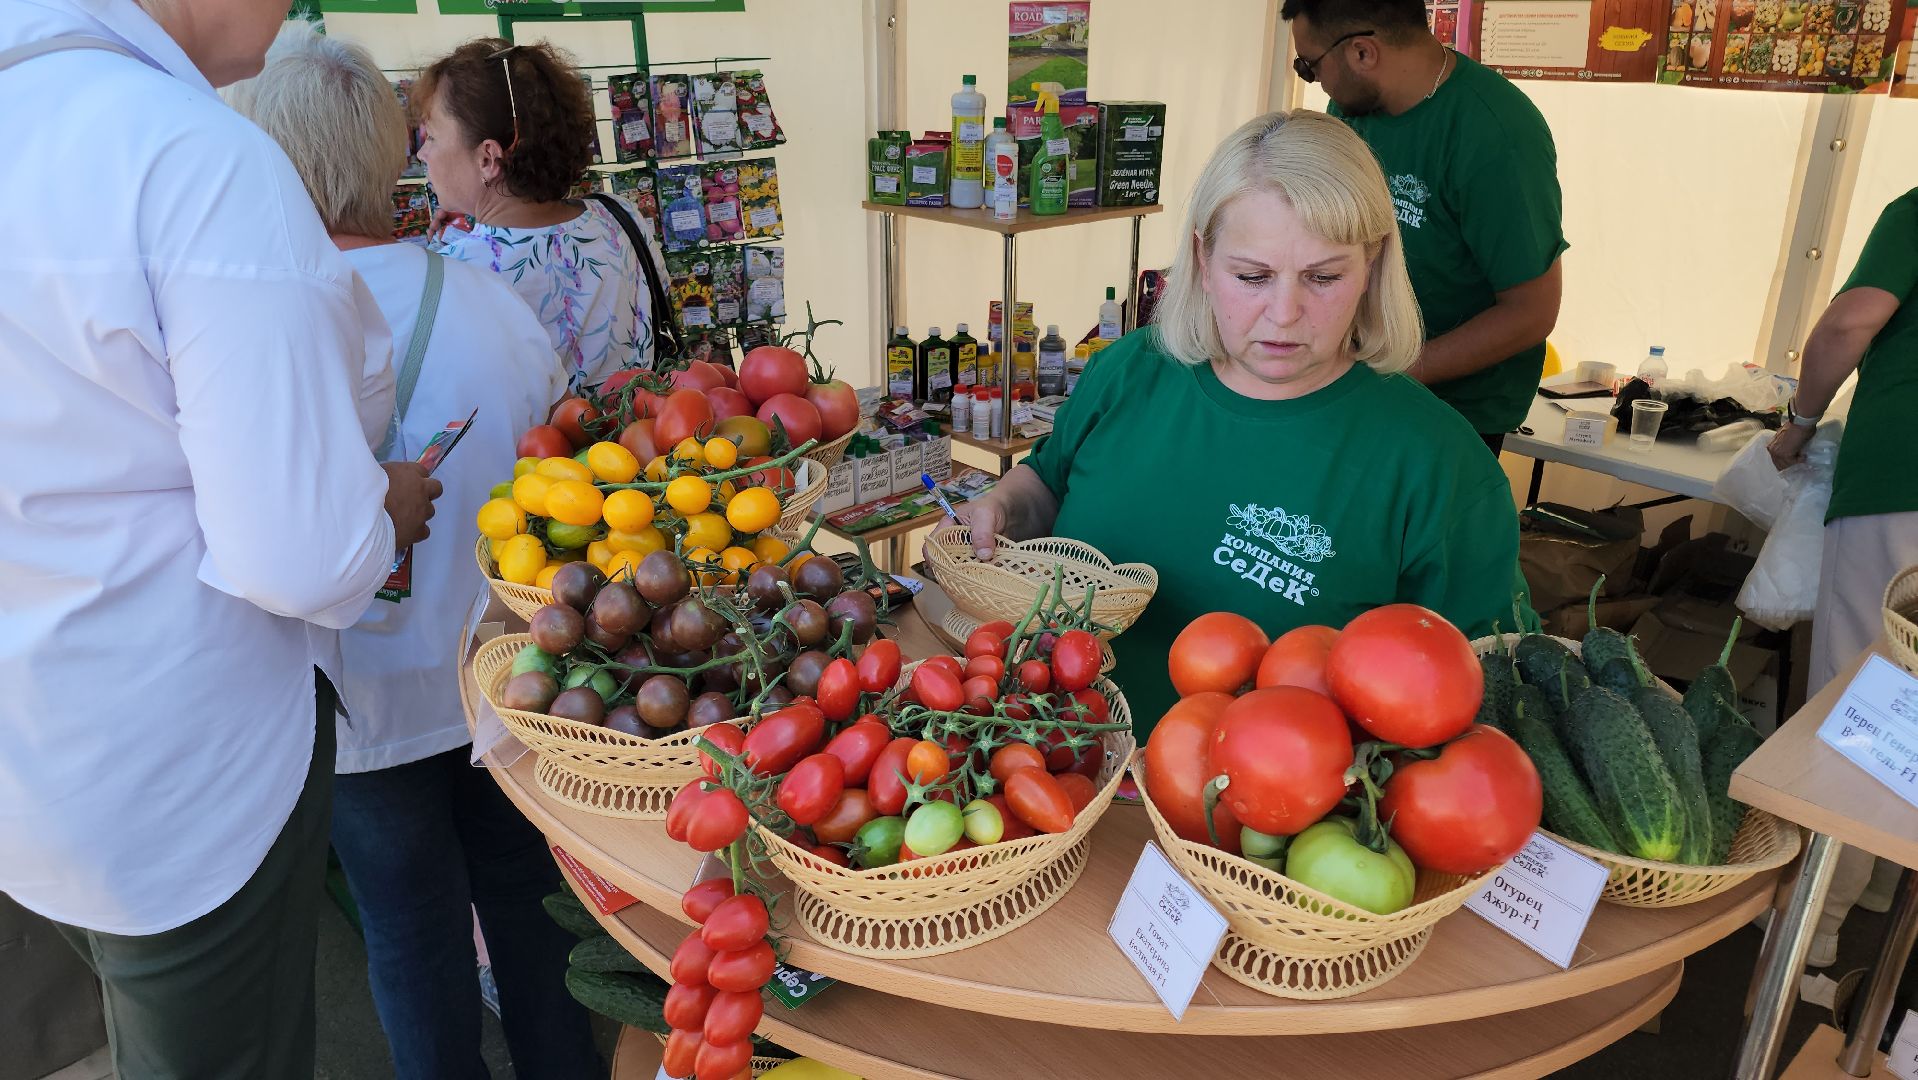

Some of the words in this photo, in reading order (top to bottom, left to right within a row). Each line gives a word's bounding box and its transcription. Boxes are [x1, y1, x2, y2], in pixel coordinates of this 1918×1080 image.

[1014, 12, 1043, 22] ROAD
[1110, 180, 1130, 190] Green
[1130, 179, 1154, 189] Needle
[1391, 197, 1424, 216] ОМПАНИЯ
[1393, 209, 1422, 228] еДеК
[1221, 533, 1315, 585] КОМПАНИЯ
[1882, 731, 1918, 763] Генер
[1494, 875, 1544, 913] Огурец
[1482, 890, 1540, 931] Ажур-F1
[1135, 927, 1170, 973] Екатерина
[1148, 922, 1170, 951] Томат
